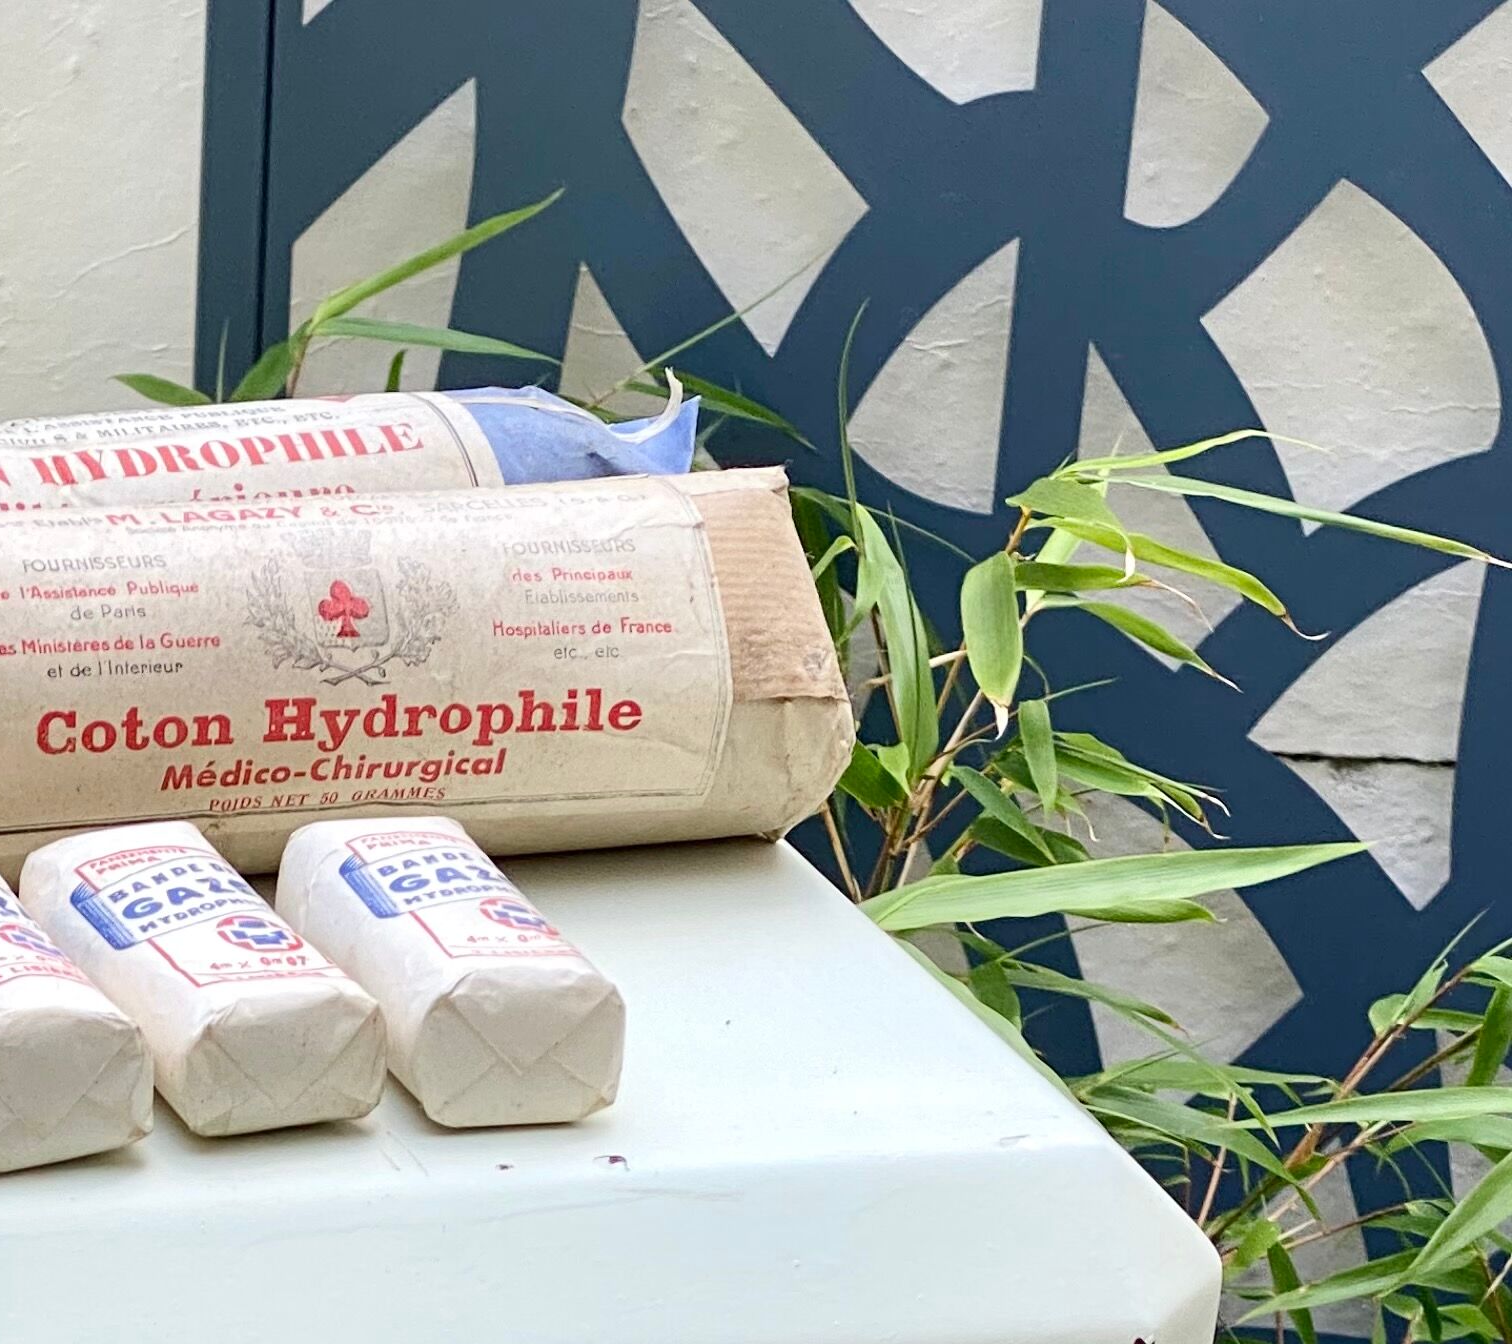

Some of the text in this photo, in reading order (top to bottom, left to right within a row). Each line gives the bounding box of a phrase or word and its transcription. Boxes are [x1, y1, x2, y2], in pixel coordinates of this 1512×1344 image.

[29, 422, 425, 486] HYDROPHILE
[159, 506, 304, 524] LAGAZY
[502, 538, 637, 558] FOURNISSEURS
[21, 554, 169, 574] FOURNISSEURS
[511, 566, 634, 584] des Principaux
[19, 585, 118, 601] l'Assistance
[126, 580, 201, 598] Publique
[524, 588, 640, 605] Etablissements
[70, 603, 148, 622] de Paris
[492, 615, 673, 640] Hospitaliers de France
[113, 635, 135, 651] de
[139, 633, 156, 650] la
[159, 631, 222, 650] Guerre
[46, 664, 64, 679] et
[69, 661, 93, 678] de
[35, 687, 644, 756] Coton Hydrophile
[160, 747, 508, 792] Médico-Chirurgical
[208, 786, 448, 813] POIDS NET 50 GRAMMES
[377, 851, 475, 878] BANDE
[108, 863, 205, 904] BANDE
